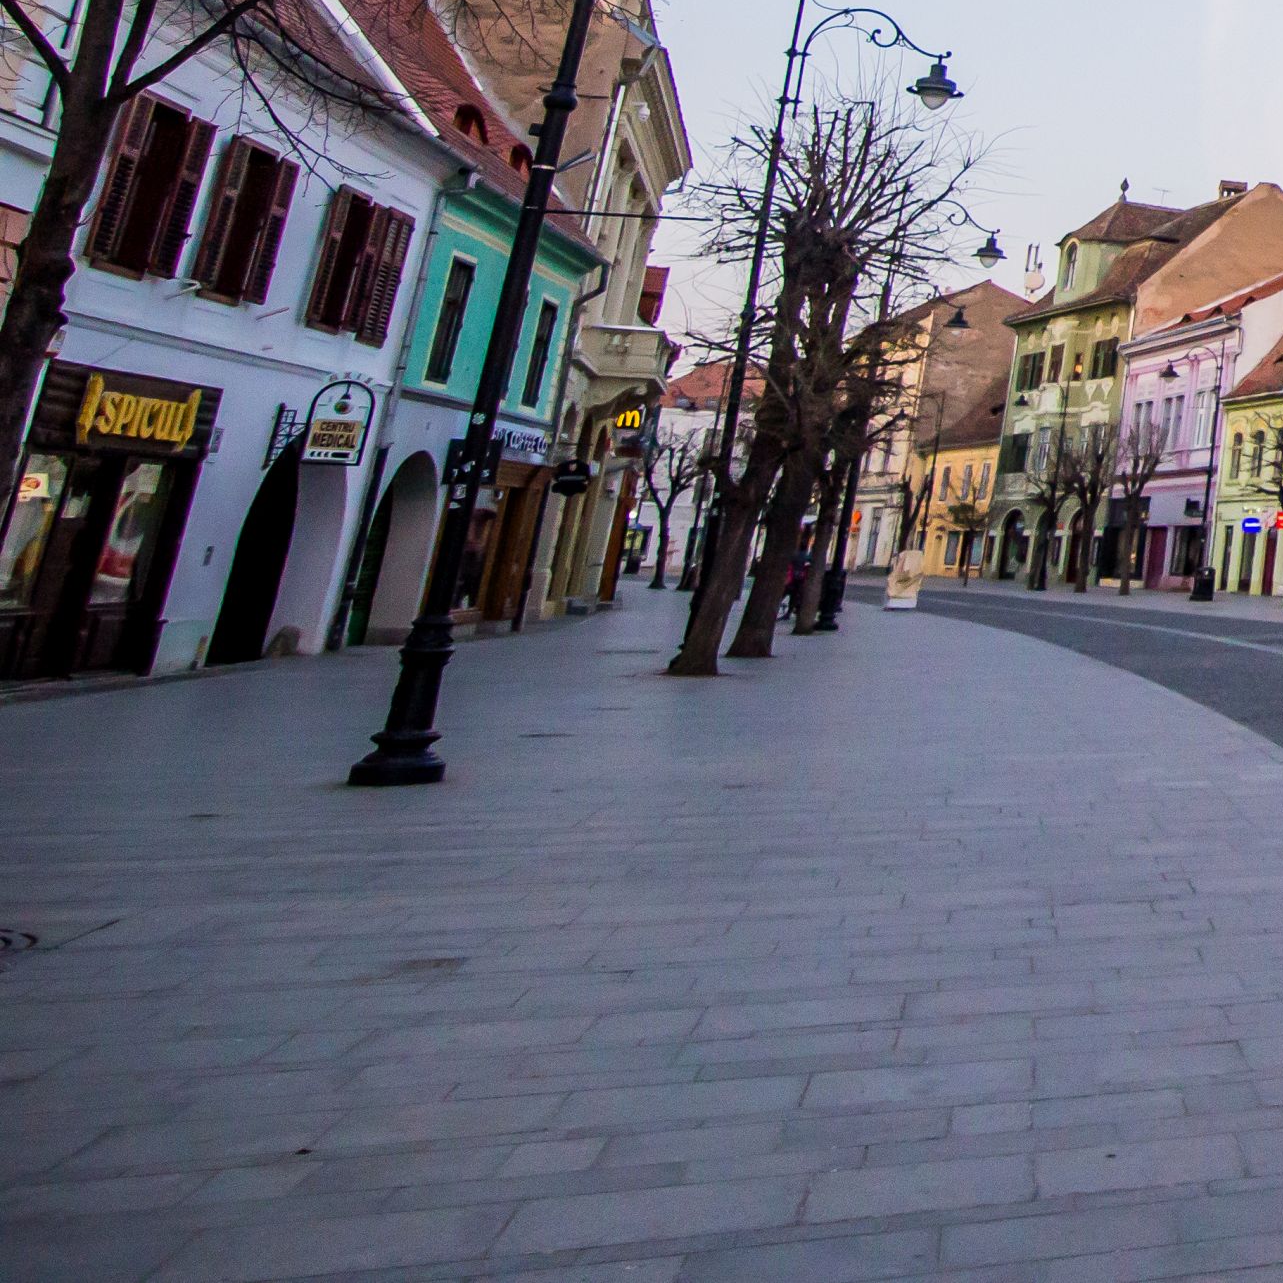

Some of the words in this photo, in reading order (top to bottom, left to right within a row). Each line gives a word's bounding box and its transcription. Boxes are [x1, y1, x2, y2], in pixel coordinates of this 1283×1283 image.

[95, 391, 188, 442] SPICUL
[320, 421, 357, 433] CENTRU
[310, 432, 357, 449] MEDICAL
